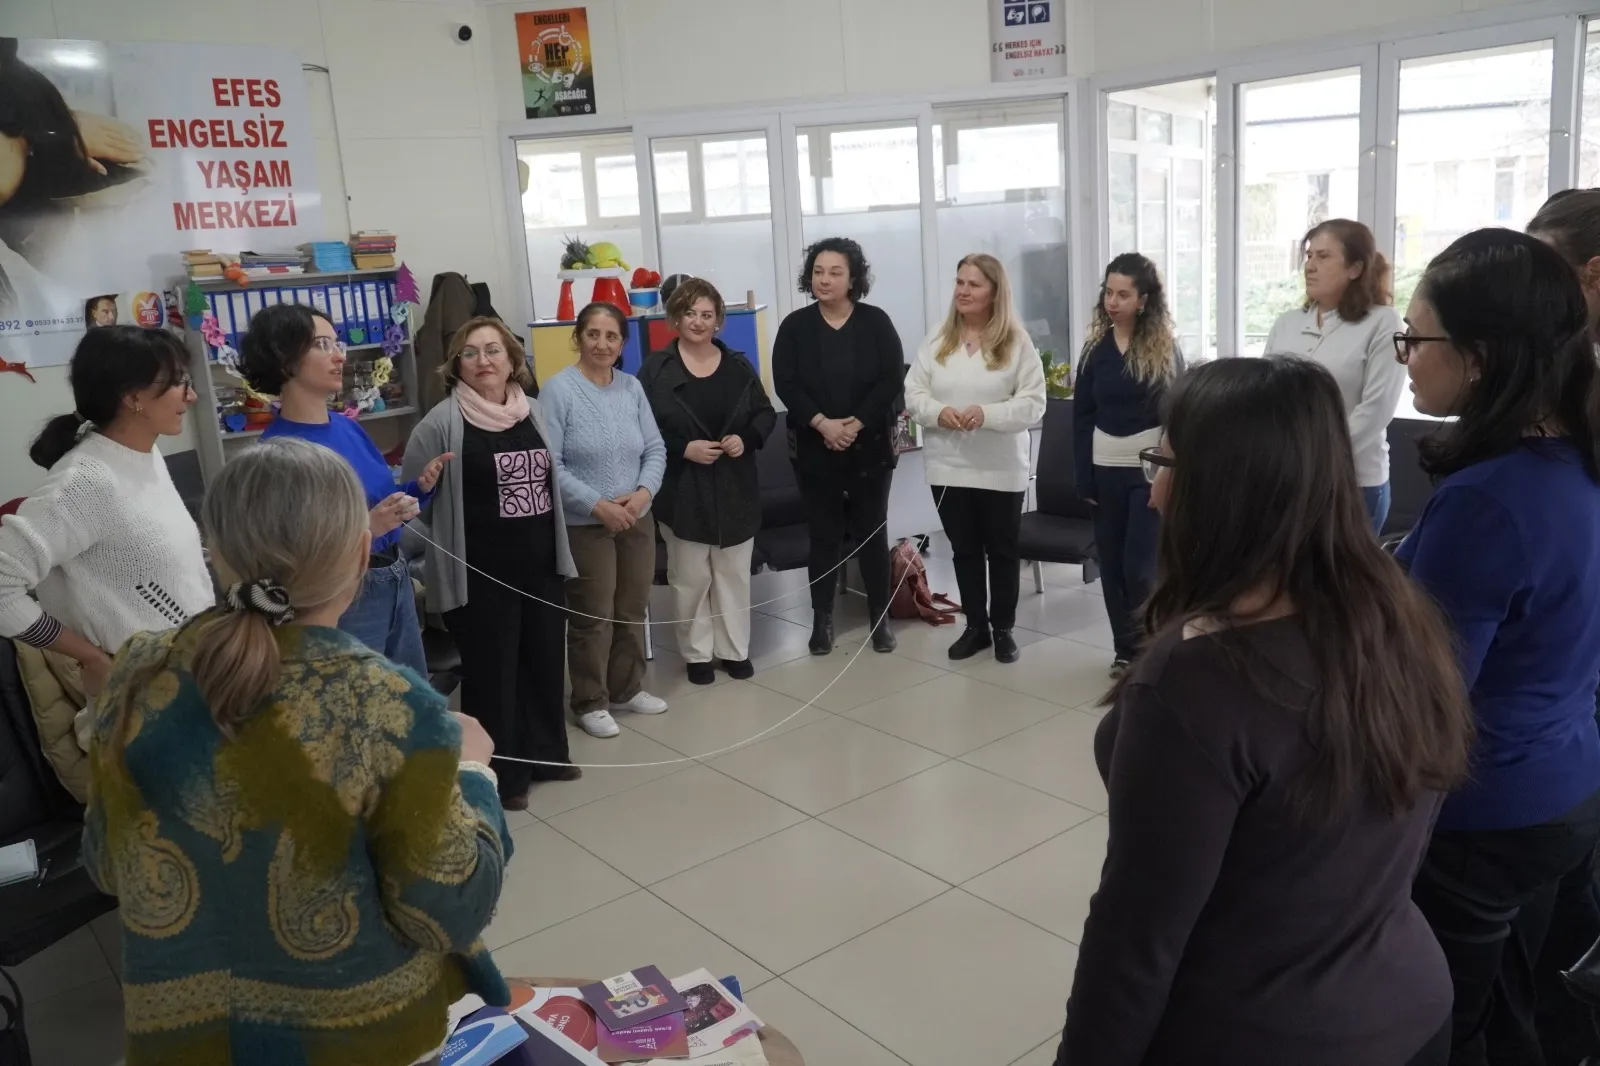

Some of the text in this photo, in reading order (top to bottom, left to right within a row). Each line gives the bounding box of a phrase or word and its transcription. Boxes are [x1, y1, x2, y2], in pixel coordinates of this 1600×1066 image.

[544, 42, 569, 60] HEP
[1004, 40, 1028, 49] HERKES
[1034, 48, 1054, 57] HAYAT
[212, 78, 281, 108] EFES
[148, 113, 287, 148] ENGELSİZ
[196, 160, 292, 195] YAŞAM
[173, 192, 297, 230] MERKEZİ
